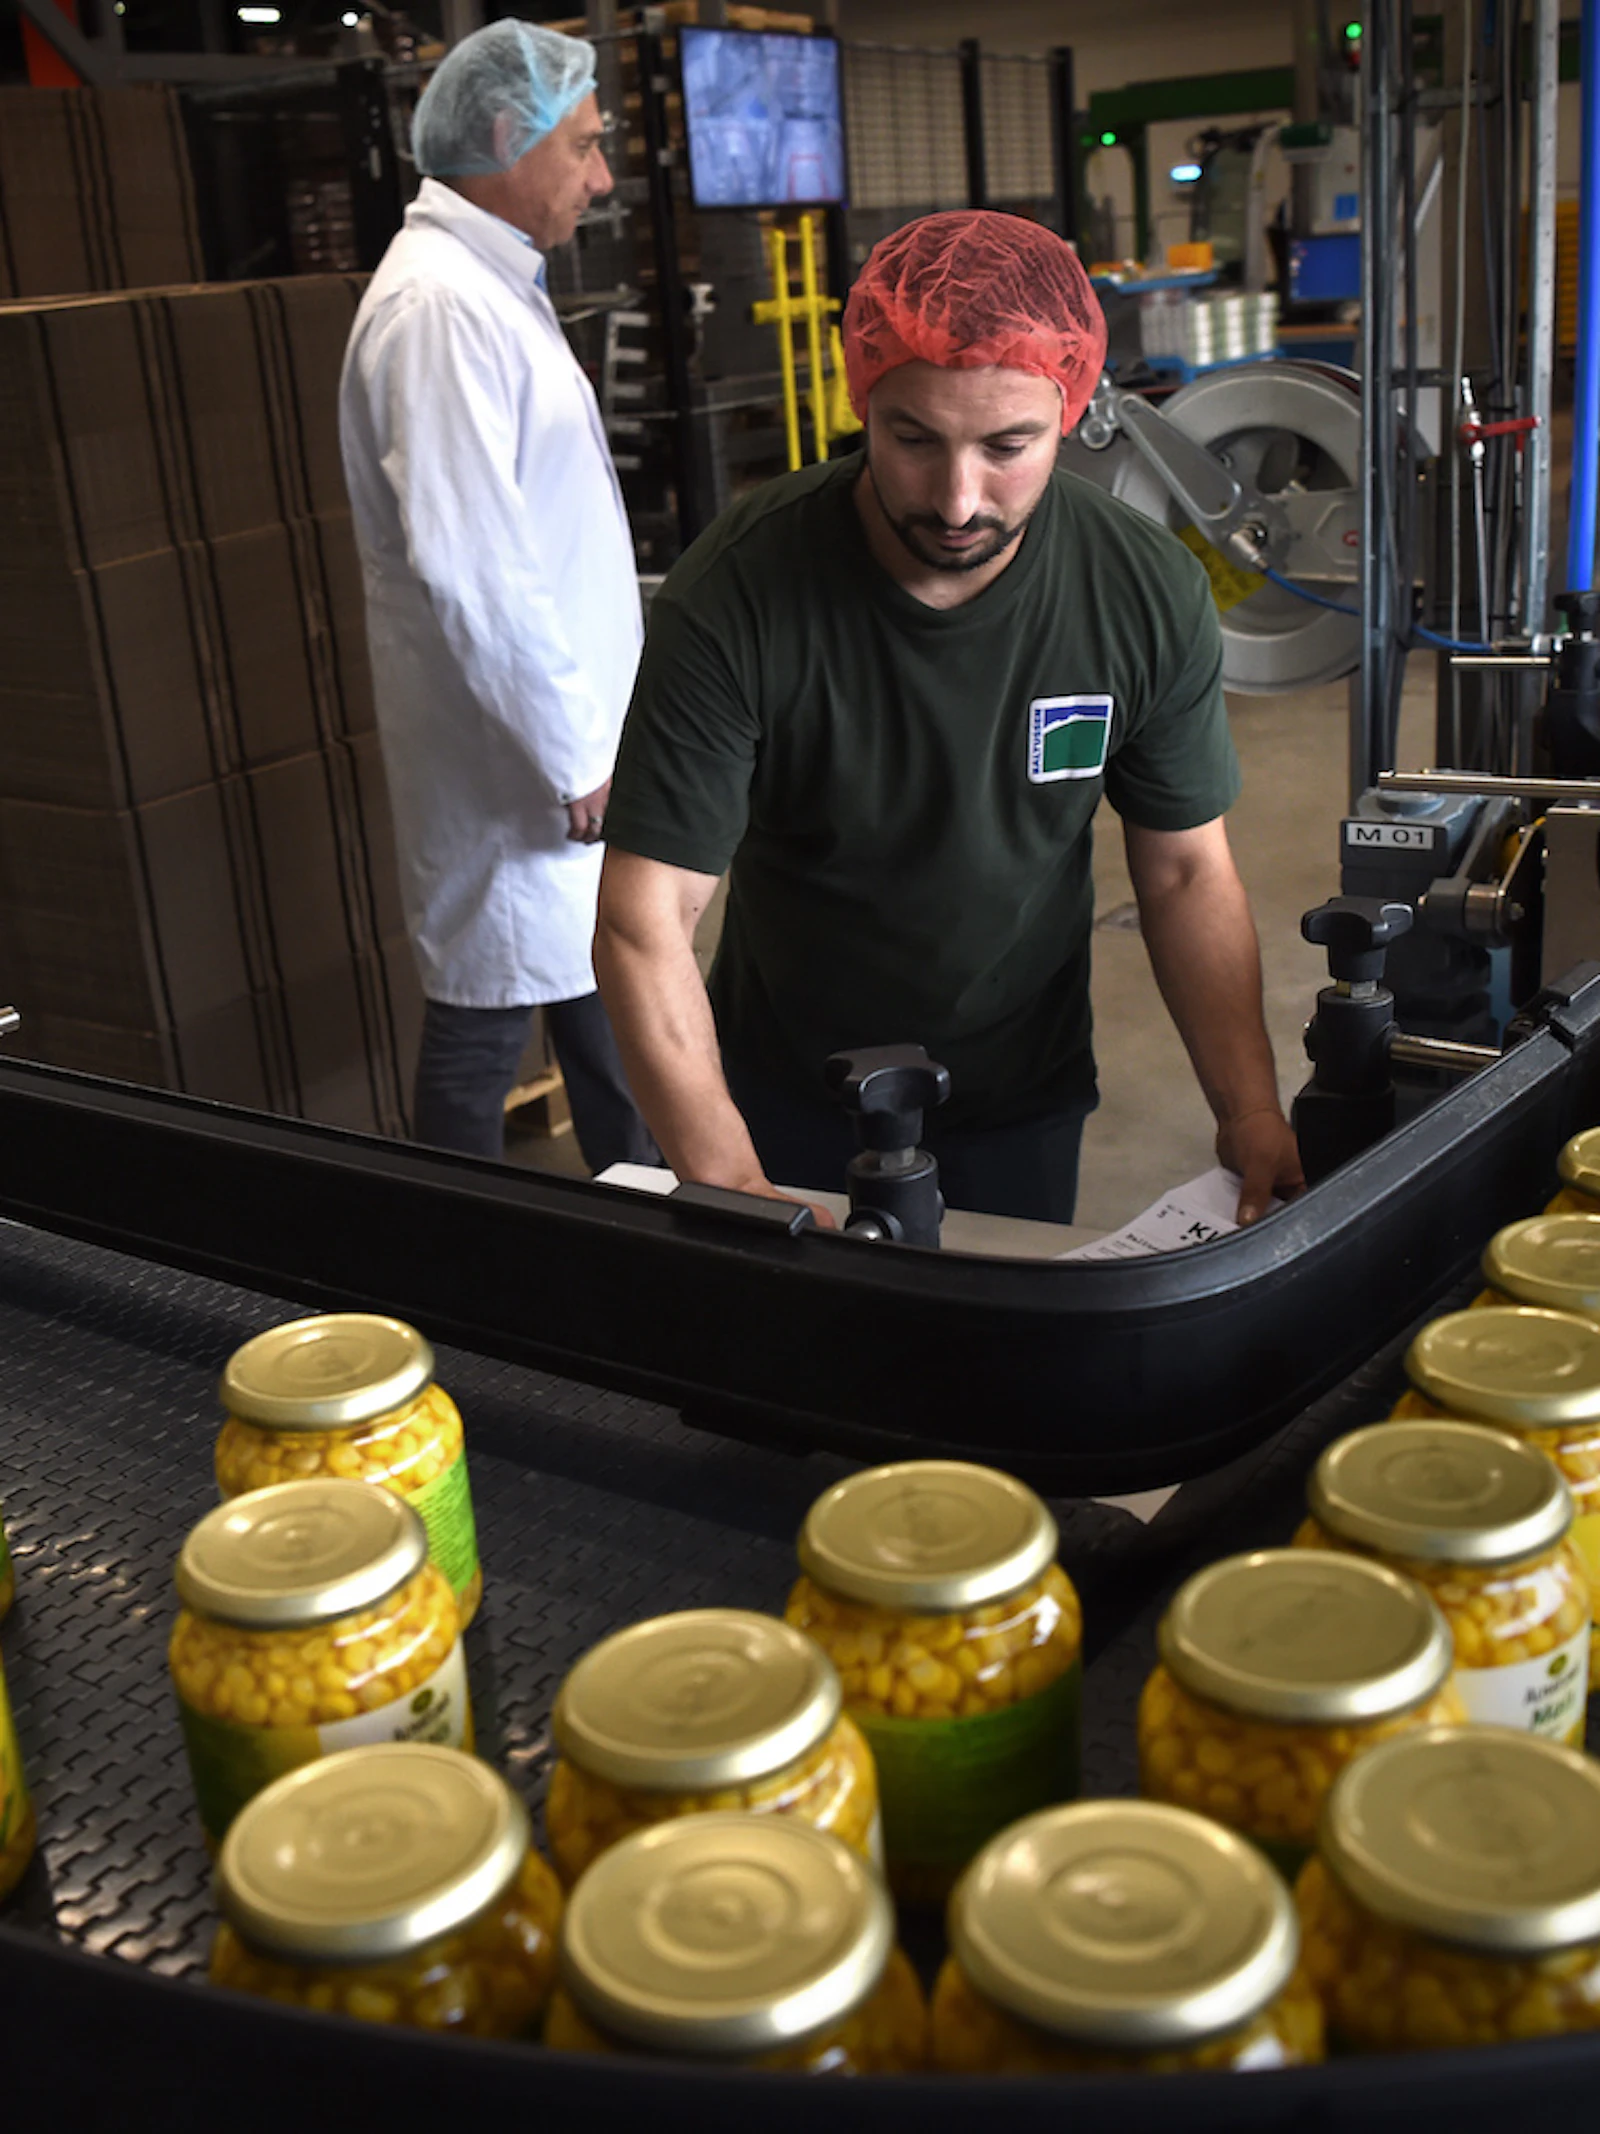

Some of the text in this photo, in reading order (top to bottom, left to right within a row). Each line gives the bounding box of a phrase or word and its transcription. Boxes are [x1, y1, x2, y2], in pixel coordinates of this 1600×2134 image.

[1032, 709, 1041, 775] BALTUSSEN
[1356, 827, 1425, 845] M 01
